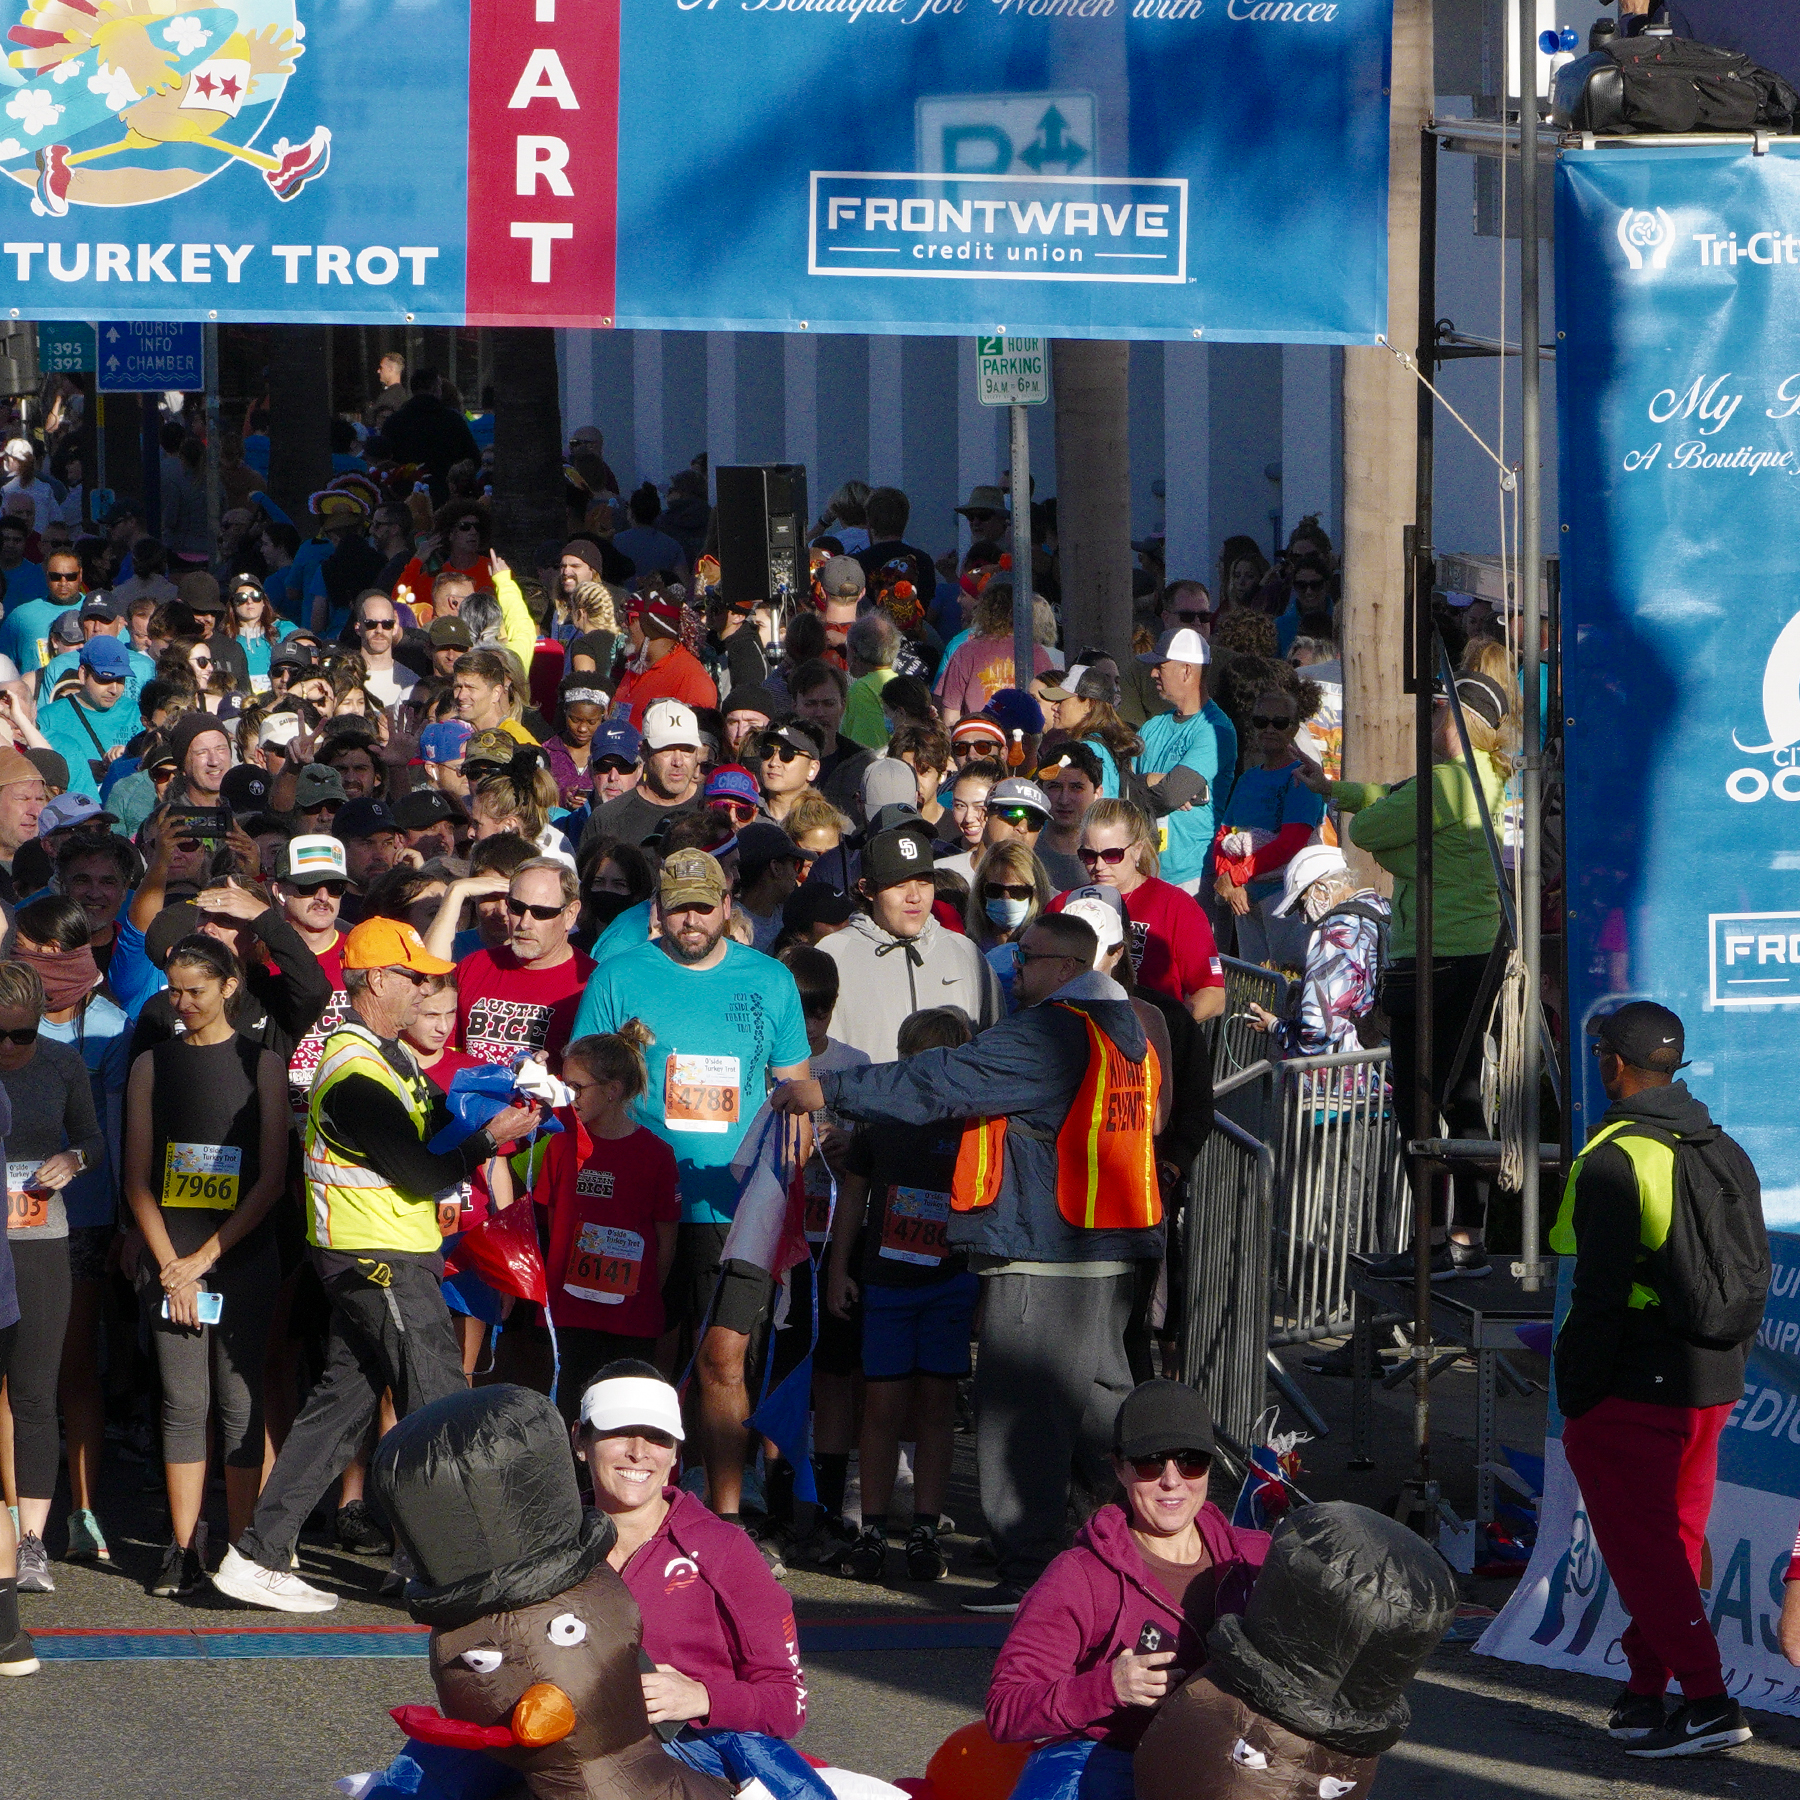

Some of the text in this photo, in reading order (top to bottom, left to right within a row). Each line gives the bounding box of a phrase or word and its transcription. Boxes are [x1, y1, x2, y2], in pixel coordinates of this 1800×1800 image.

[507, 0, 581, 284] ART
[829, 198, 1169, 237] FRONTWAVE
[912, 240, 1083, 262] credit union
[4, 243, 255, 284] TURKEY
[271, 245, 439, 286] TROT
[141, 337, 172, 352] INFO
[1006, 337, 1039, 353] HOUR
[126, 355, 194, 371] CHAMBER
[982, 357, 1042, 376] PARKING
[1648, 372, 1742, 435] My
[1624, 441, 1659, 473] A
[1667, 438, 1794, 479] Boutique
[1015, 784, 1042, 804] YETI
[898, 837, 918, 860] SD
[471, 997, 555, 1021] AUSTIN
[466, 1011, 551, 1050] BICE
[677, 1087, 734, 1111] 4788
[203, 1153, 223, 1161] Turkey
[10, 1171, 29, 1179] Turkey
[175, 1174, 232, 1200] 7966
[577, 1254, 631, 1284] 6141
